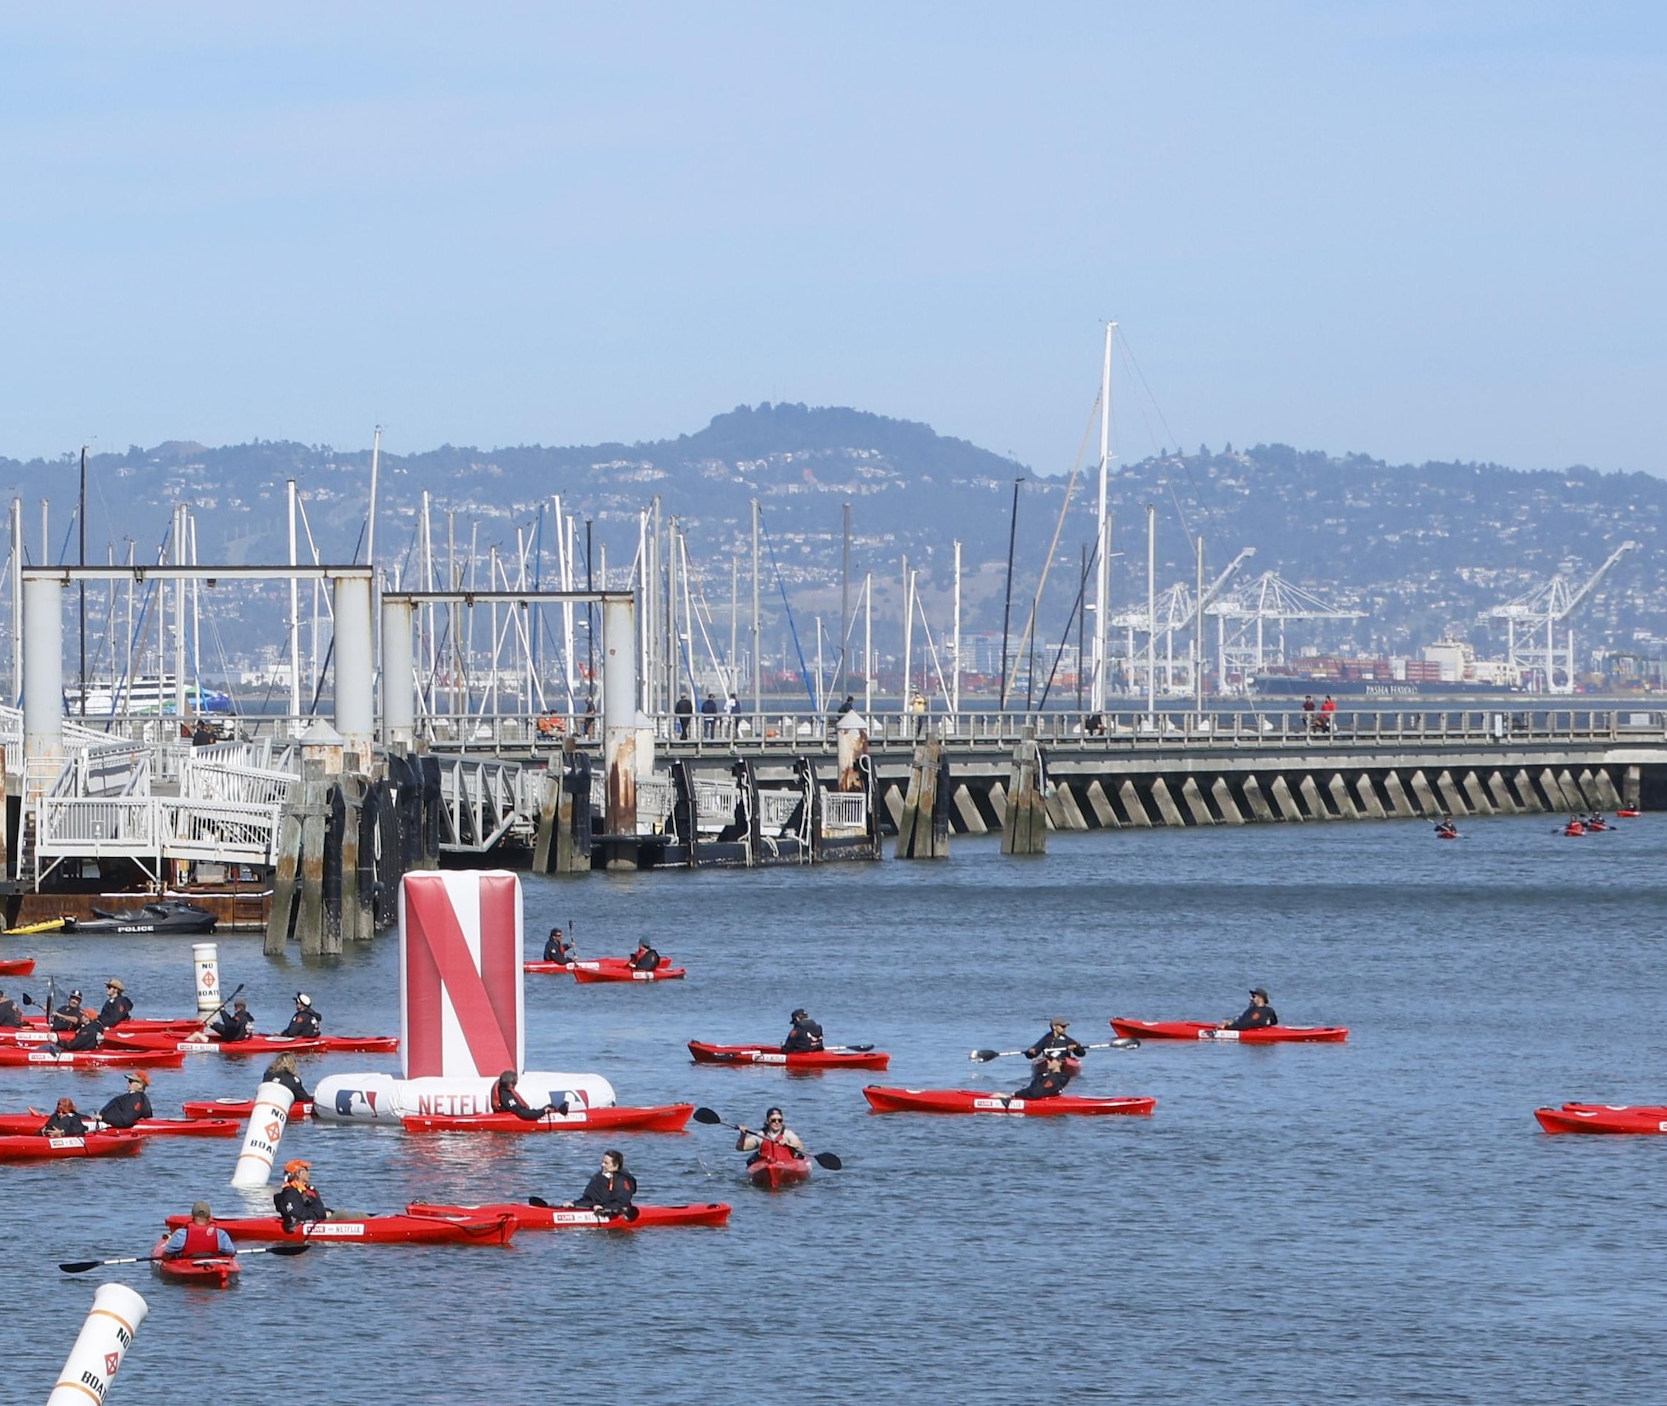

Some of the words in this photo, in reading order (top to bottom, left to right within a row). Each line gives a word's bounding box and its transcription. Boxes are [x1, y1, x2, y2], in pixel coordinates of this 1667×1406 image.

[117, 925, 154, 933] POLICE
[197, 989, 218, 997] BOAT
[418, 1095, 489, 1116] NETFLI
[270, 1108, 285, 1122] NO
[250, 1139, 276, 1157] BOAT
[336, 1225, 362, 1234] NETFLIX
[116, 1327, 131, 1349] NO
[80, 1370, 108, 1402] BOAT
